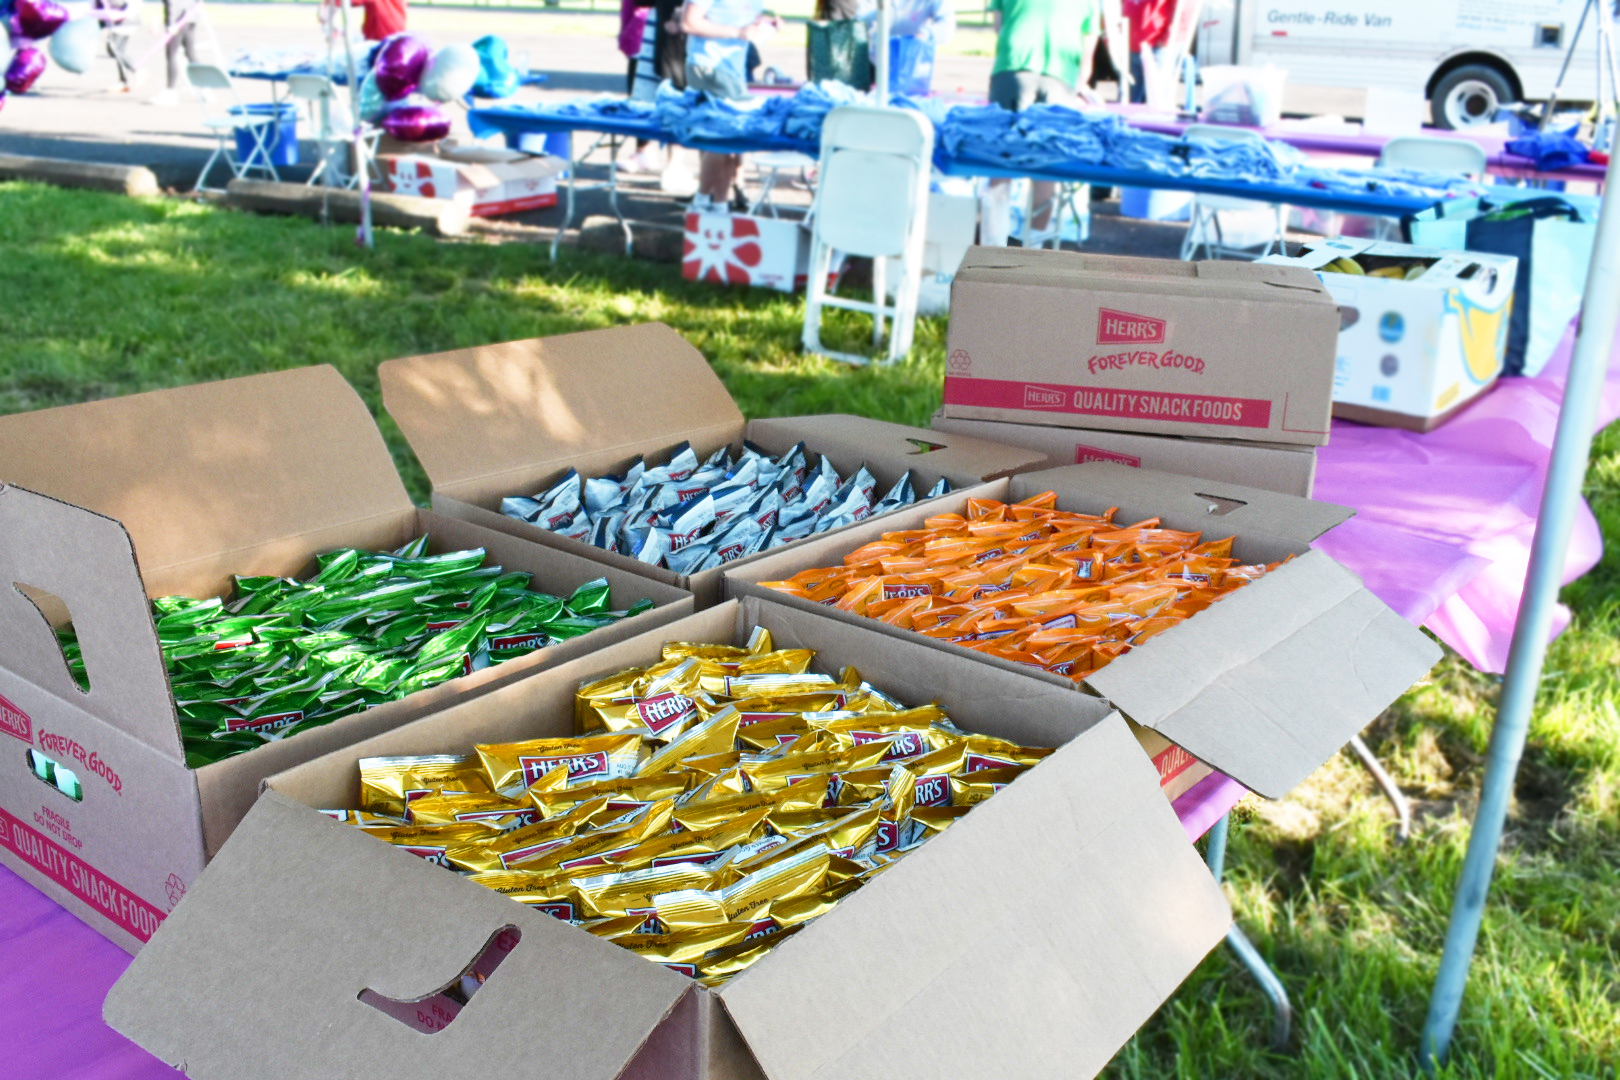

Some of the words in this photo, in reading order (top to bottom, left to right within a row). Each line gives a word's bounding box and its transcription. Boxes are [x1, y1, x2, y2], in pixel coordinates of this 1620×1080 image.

[1267, 9, 1358, 26] Gentle-Ride
[1364, 13, 1393, 28] Van
[1105, 318, 1158, 339] HERR'S
[1087, 350, 1160, 375] FOREVER
[1028, 390, 1061, 404] HERR'S
[1073, 390, 1137, 412] QUALITY
[1139, 396, 1191, 417] SNACK
[1192, 399, 1243, 421] FOODS
[38, 728, 90, 771] FOREVER
[537, 744, 562, 752] Gluten
[736, 803, 760, 813] Gluten
[760, 800, 776, 809] Free
[41, 805, 72, 831] FRAGILE
[33, 811, 45, 827] DO
[46, 821, 61, 838] NOT
[62, 831, 83, 850] DROP
[391, 831, 418, 840] Gluten
[512, 831, 536, 845] Gluten
[536, 825, 555, 837] Free
[574, 839, 598, 853] Gluten
[669, 839, 695, 850] Gluten
[695, 835, 712, 844] Free
[12, 823, 68, 881] QUALITY
[70, 860, 120, 916] SNACK
[119, 893, 164, 936] FOOD
[526, 884, 547, 892] Free
[749, 897, 769, 910] Free
